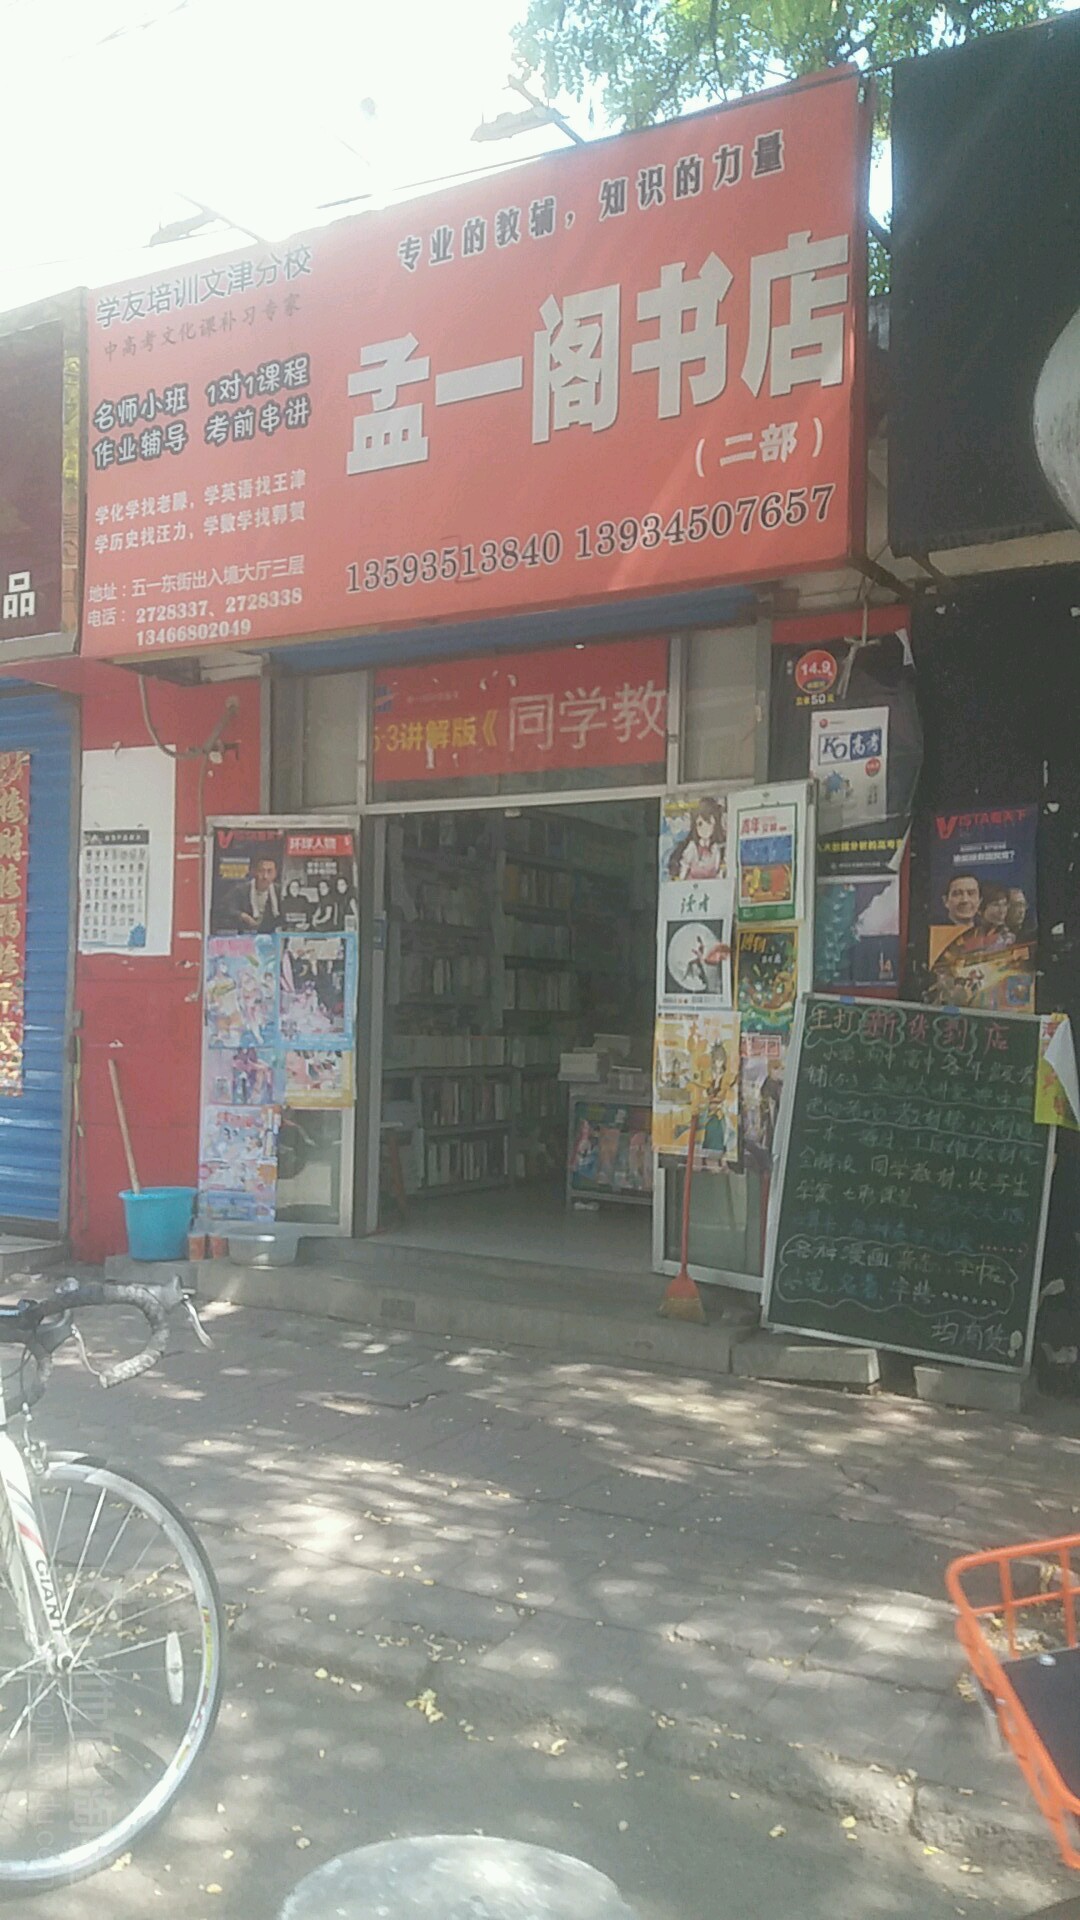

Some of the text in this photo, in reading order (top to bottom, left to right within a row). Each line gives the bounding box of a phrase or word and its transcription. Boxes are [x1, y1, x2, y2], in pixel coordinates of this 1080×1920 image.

[95, 244, 312, 328] 学友培训文津分校
[103, 292, 302, 361] 中高考文化课补习专家
[345, 229, 850, 476] 孟一阁书店
[92, 352, 311, 433] 名师小班 1对1课程
[92, 395, 311, 470] 作业辅导 考前串讲
[346, 483, 836, 593] 13593513840 13934507657
[3, 570, 36, 620] 品
[135, 618, 251, 647] 13466802049
[35, 1559, 66, 1636] GIANT
